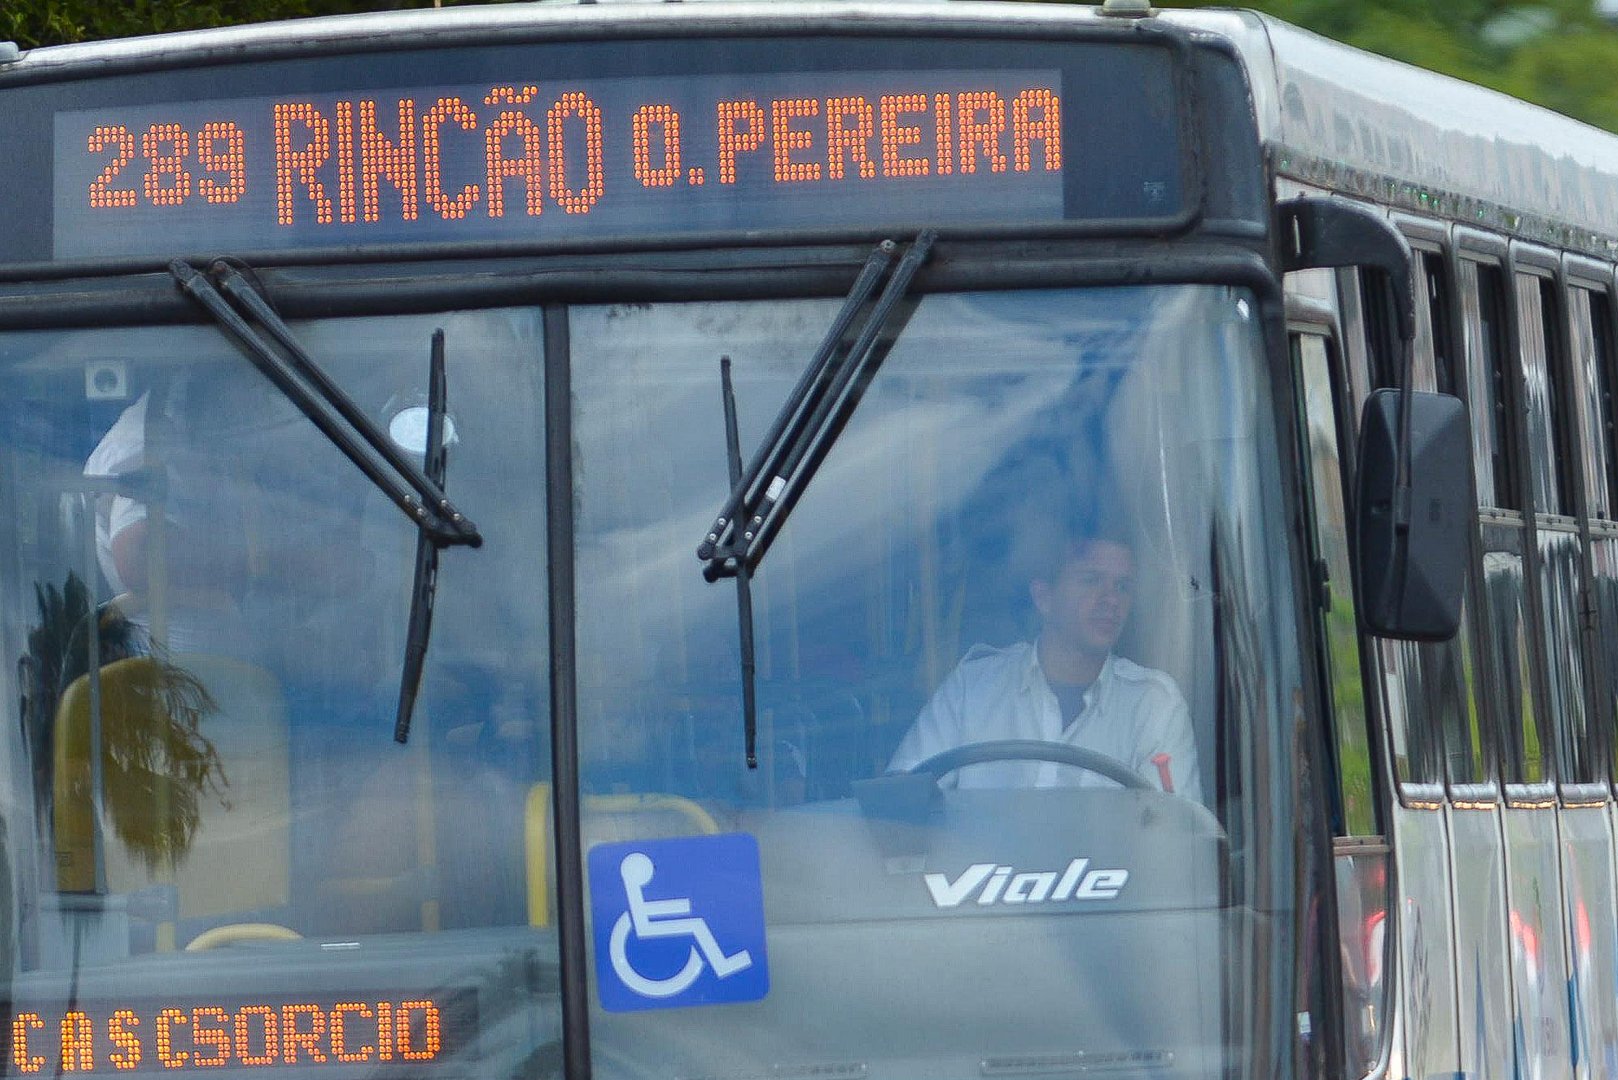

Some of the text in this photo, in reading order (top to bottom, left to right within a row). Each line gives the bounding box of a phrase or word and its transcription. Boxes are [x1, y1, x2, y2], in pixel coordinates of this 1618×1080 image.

[87, 121, 245, 207] 289
[274, 85, 603, 225] RINCÃO
[923, 857, 1130, 908] Viale
